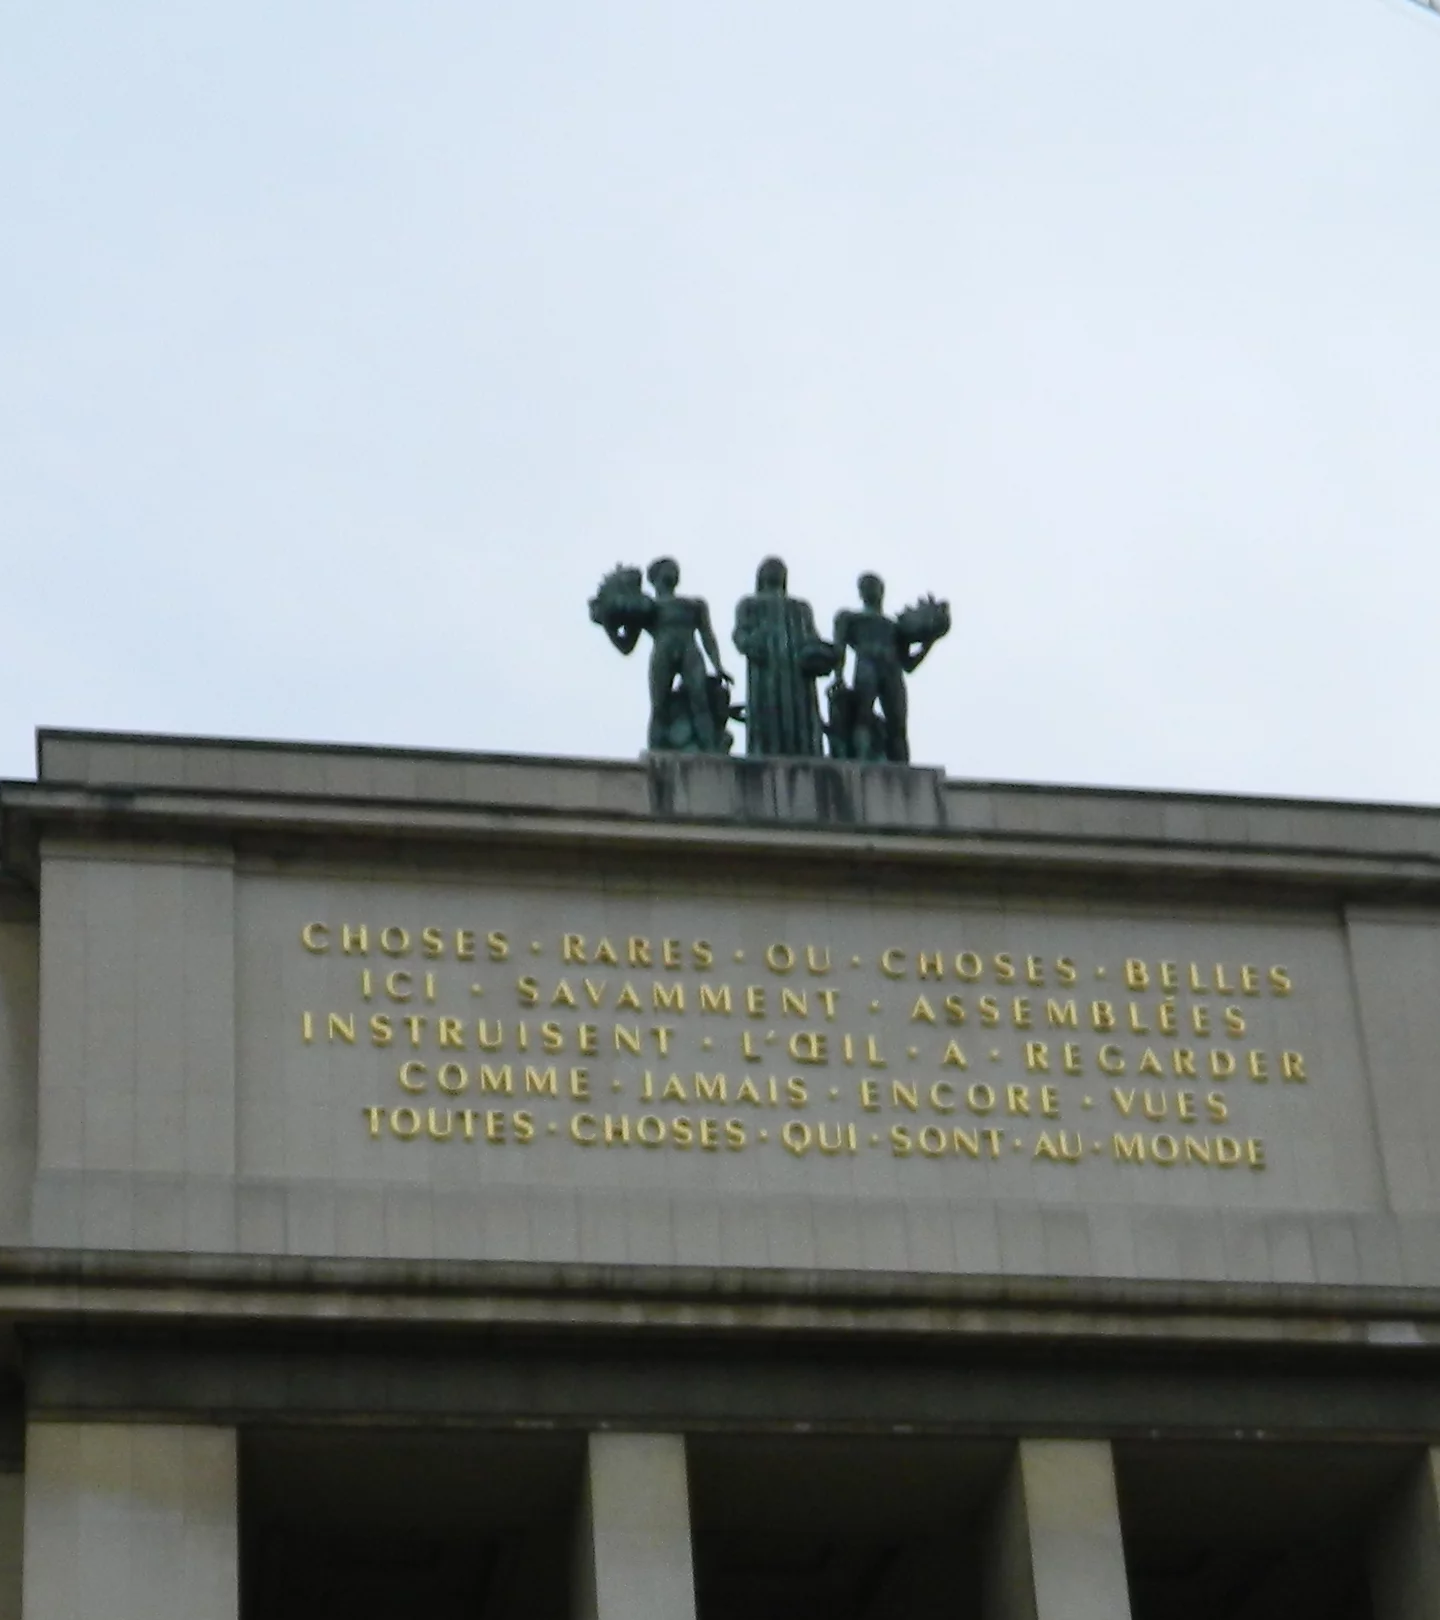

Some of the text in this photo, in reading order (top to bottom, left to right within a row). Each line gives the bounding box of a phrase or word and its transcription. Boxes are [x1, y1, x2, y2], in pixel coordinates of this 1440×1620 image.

[301, 921, 1292, 997] CHOSES RARES OU CHOSES BELLES
[361, 967, 1246, 1039] ICI SAVAMMENT ASSEMBLÉES
[302, 1010, 675, 1058] INSTRUISENT
[942, 1038, 969, 1071] A
[1024, 1041, 1307, 1083] REGARDER
[398, 1059, 1229, 1123] COMME JAMAIS ENCORE VUES
[361, 1104, 1267, 1171] TOUTES CHOSES QUI SONT AU MONDE
